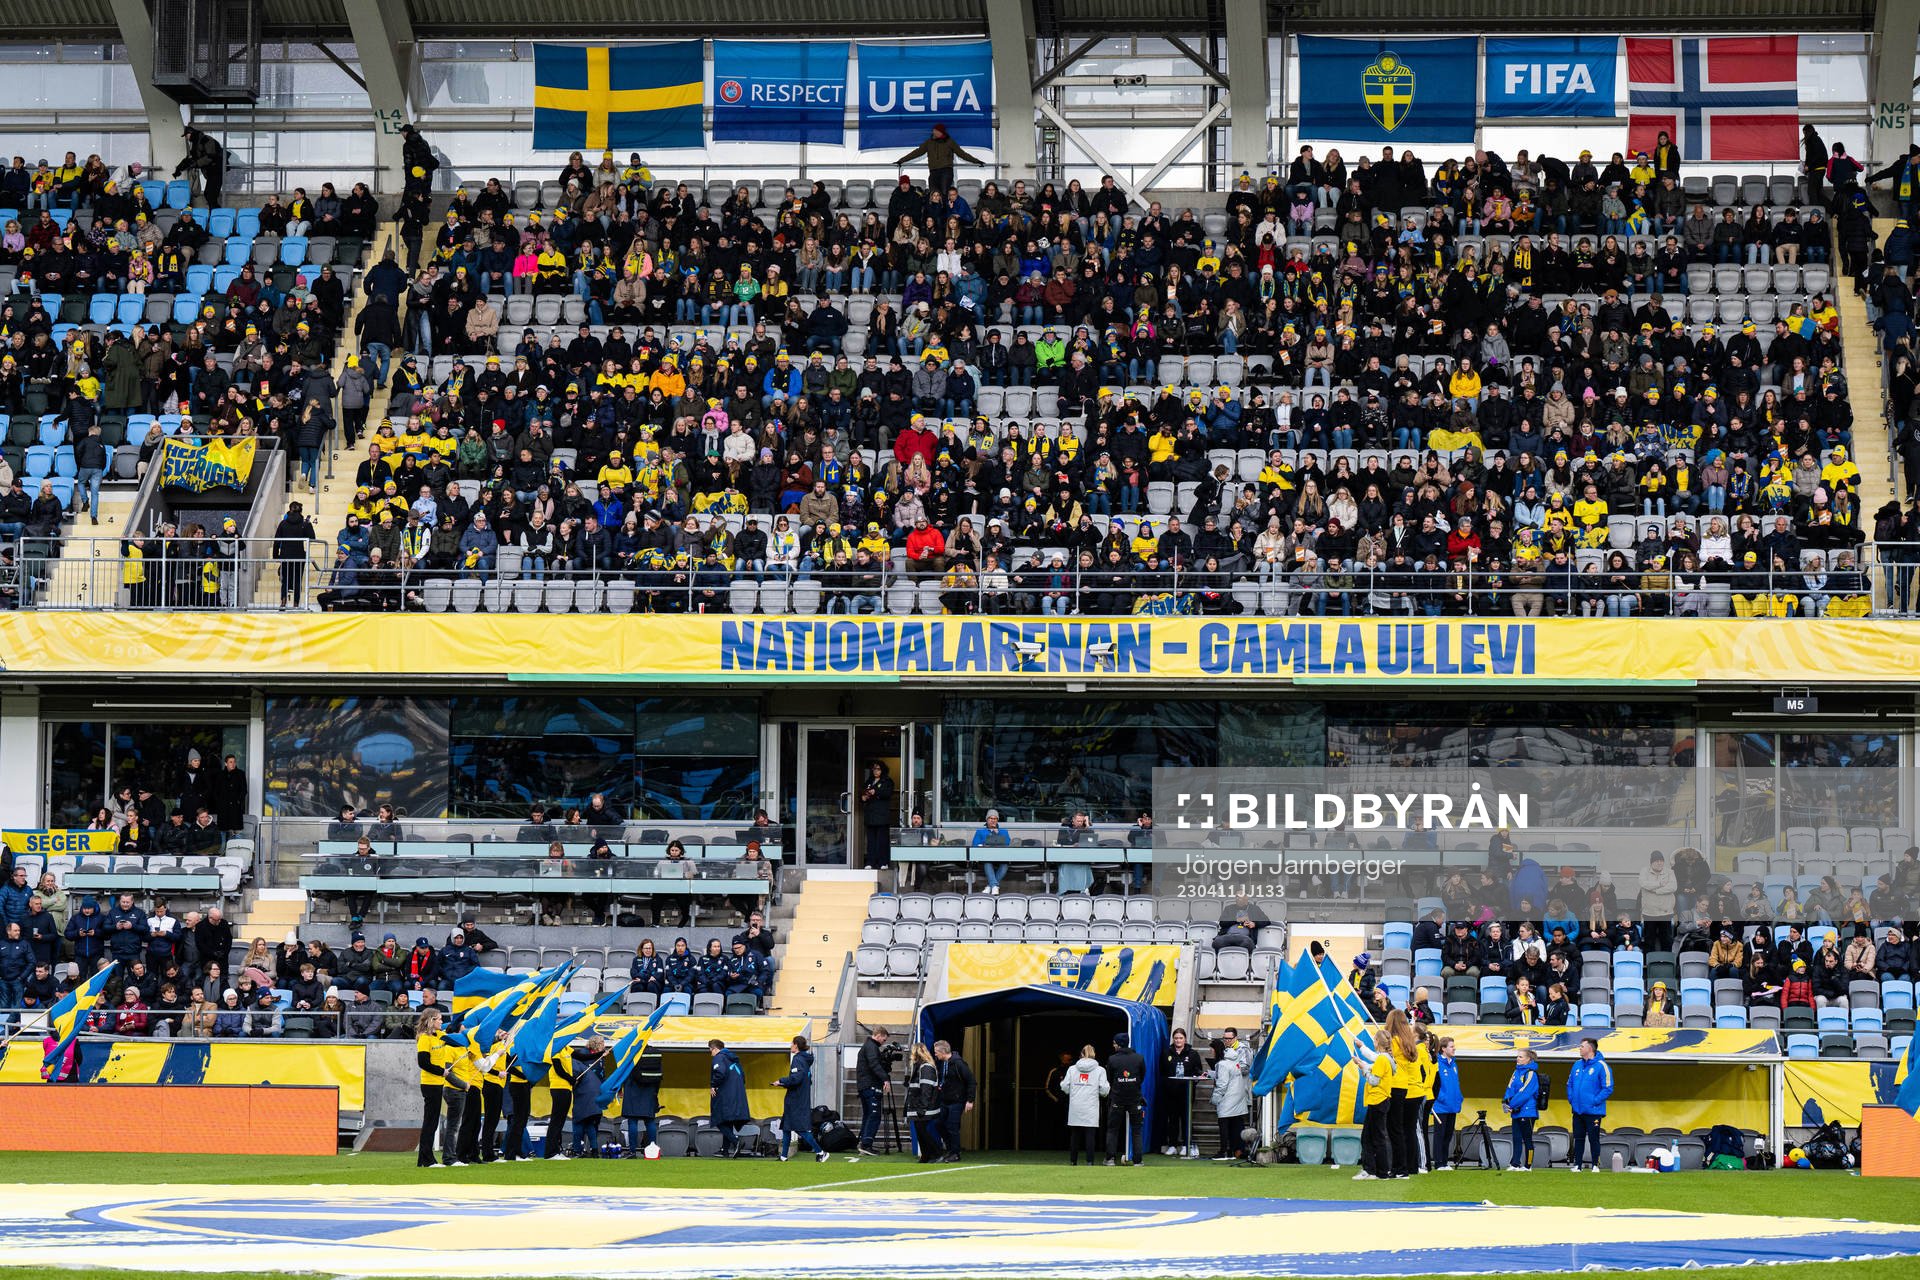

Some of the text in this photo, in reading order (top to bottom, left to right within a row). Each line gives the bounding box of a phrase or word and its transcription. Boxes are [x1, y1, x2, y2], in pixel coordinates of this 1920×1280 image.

[1505, 63, 1596, 94] FIFA
[751, 83, 844, 103] RESPECT
[869, 79, 981, 113] UEFA
[1881, 102, 1907, 114] N4
[379, 108, 402, 120] L4
[1880, 115, 1905, 129] N5
[333, 453, 339, 461] 6
[95, 549, 101, 557] 3
[81, 583, 87, 591] 2
[721, 620, 1151, 673] NATIONALARENAN
[1199, 622, 1366, 675] GAMLA
[1377, 623, 1535, 675] ULLEVI
[1787, 699, 1804, 710] M5
[26, 834, 91, 852] SEGER
[823, 934, 829, 942] 6
[1324, 939, 1330, 948] 6
[816, 959, 822, 968] 5
[808, 986, 815, 994] 4
